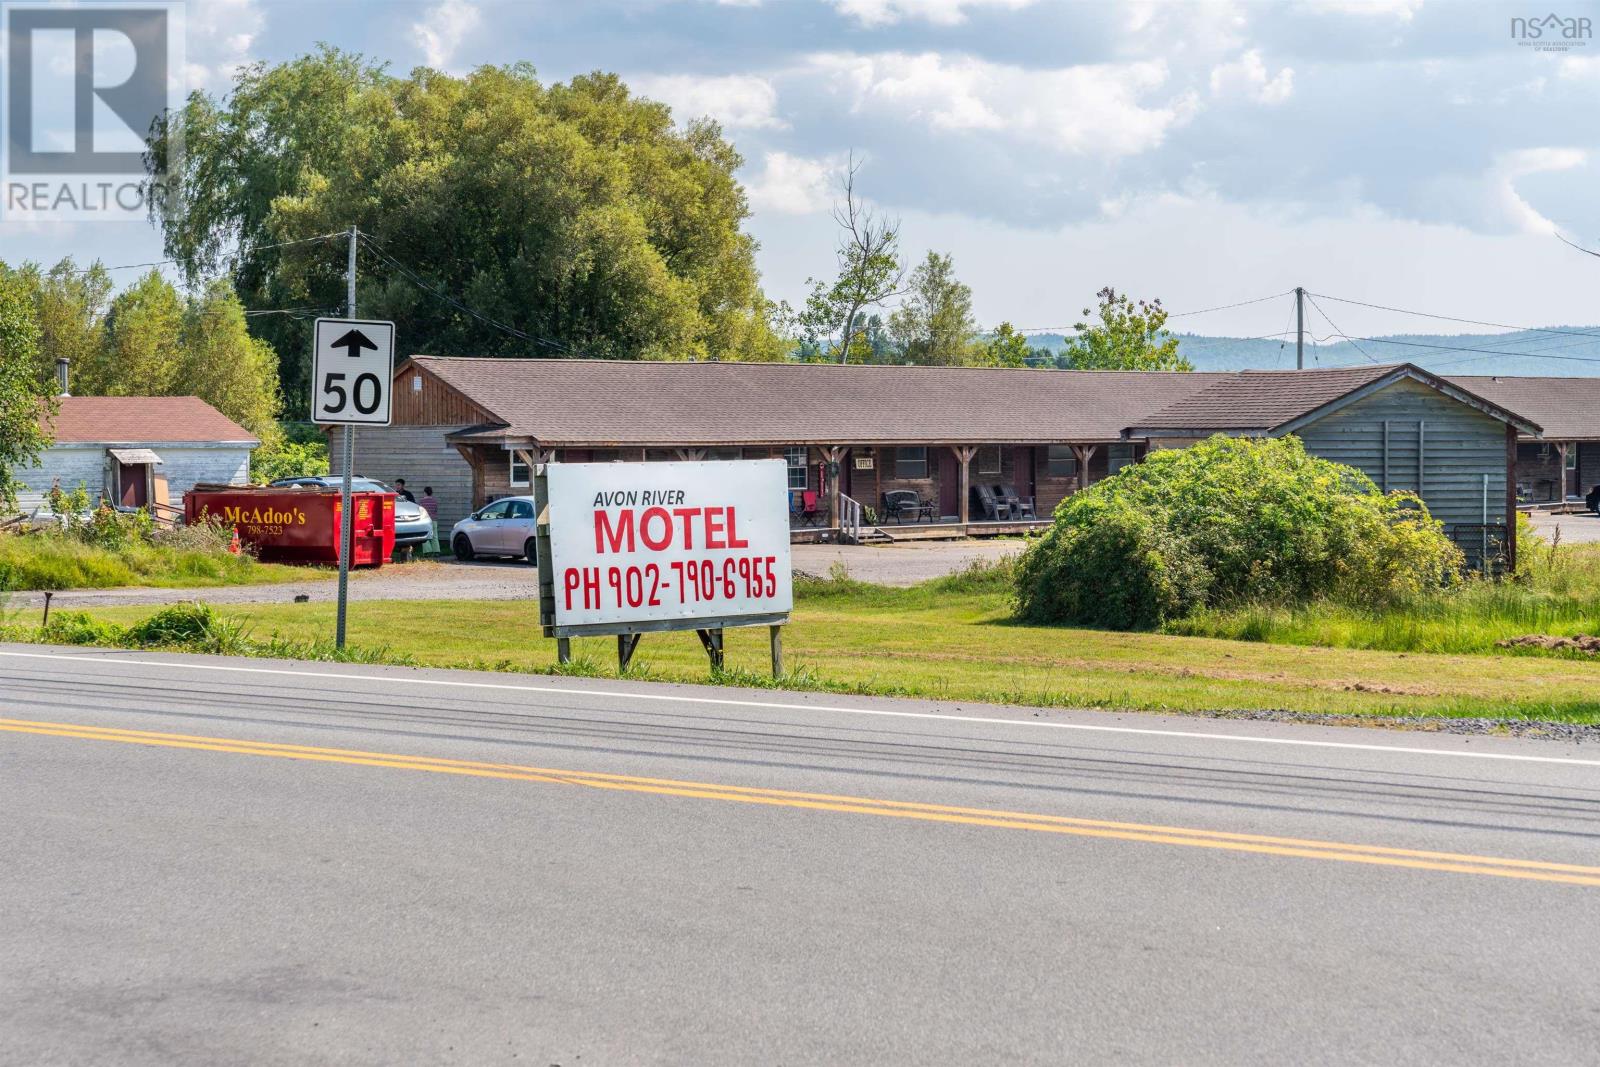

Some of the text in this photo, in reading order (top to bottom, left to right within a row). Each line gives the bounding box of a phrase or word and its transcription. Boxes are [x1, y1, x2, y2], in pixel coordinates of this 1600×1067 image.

[323, 372, 382, 415] 50
[593, 490, 685, 507] AVON RIVER
[224, 506, 306, 525] McAdoo's
[247, 525, 283, 535] 798-7523
[594, 506, 748, 554] MOTEL
[564, 556, 777, 610] PH 902-790-6955
